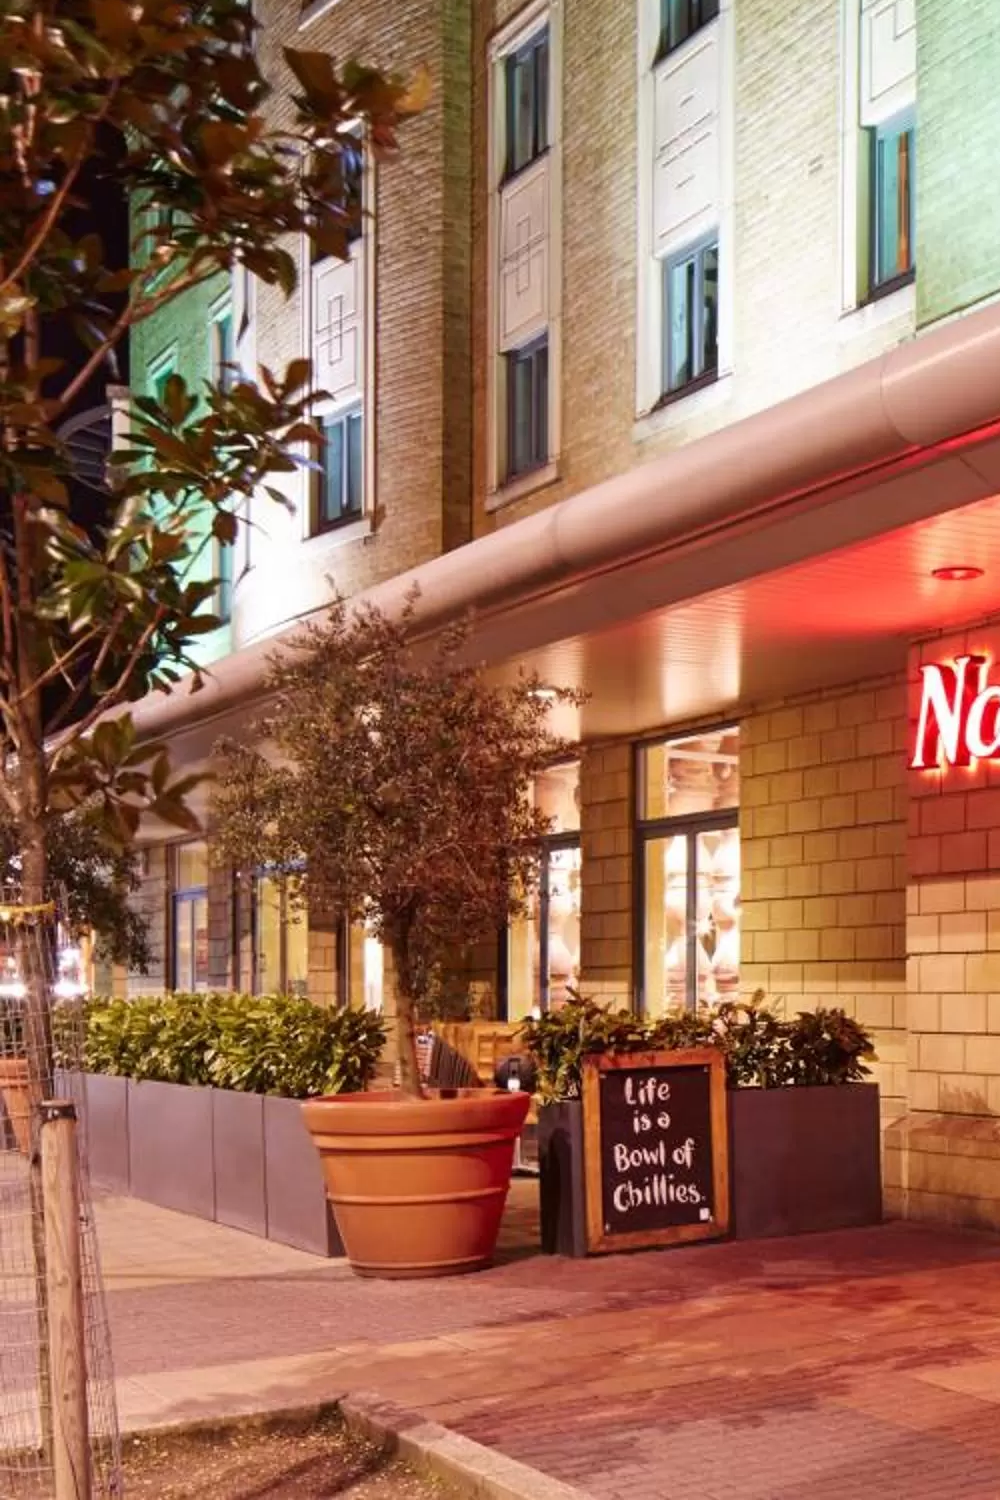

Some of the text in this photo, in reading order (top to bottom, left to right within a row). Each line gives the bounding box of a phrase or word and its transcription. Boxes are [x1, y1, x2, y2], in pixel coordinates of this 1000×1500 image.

[624, 1076, 671, 1106] Life
[633, 1109, 671, 1135] is a
[613, 1137, 695, 1173] Bowl of
